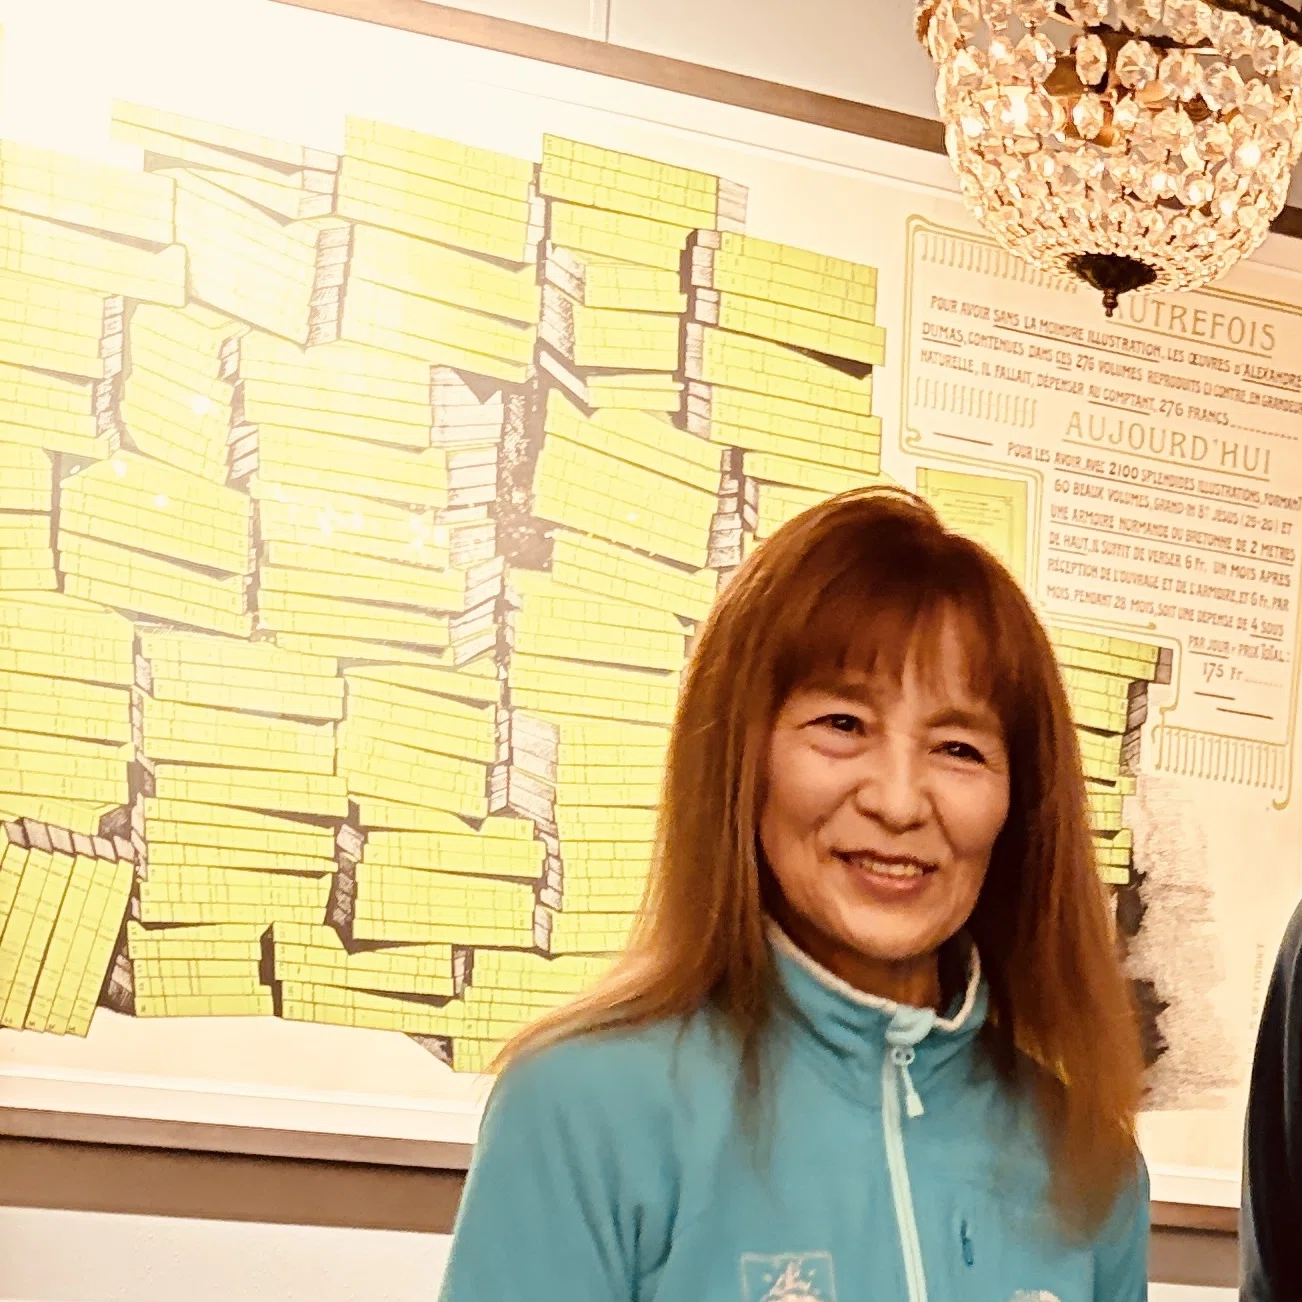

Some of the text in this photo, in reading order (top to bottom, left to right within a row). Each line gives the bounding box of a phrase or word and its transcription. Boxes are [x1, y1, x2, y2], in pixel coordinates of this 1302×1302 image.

[930, 295, 958, 313] POUR
[993, 308, 1020, 327] SANS
[1024, 316, 1037, 330] LA
[1168, 348, 1184, 362] LES
[1028, 344, 1053, 362] DANS
[1056, 350, 1072, 366] CES
[1076, 354, 1094, 372] 276
[1098, 360, 1142, 382] VOLUMES
[1159, 398, 1184, 418] 276
[1008, 442, 1032, 460] POUR
[1035, 448, 1050, 462] LES
[1108, 462, 1139, 480] 2100
[1065, 411, 1270, 474] AUJOURD'HUI
[1054, 478, 1070, 494] 60
[1073, 482, 1104, 500] BEAUX
[1050, 503, 1068, 520] UNE
[1072, 508, 1114, 529] ARMOIRE
[1119, 516, 1169, 538] NORMANDE
[1236, 538, 1247, 553] DE
[1250, 540, 1258, 554] 2
[1049, 531, 1060, 546] DE
[1133, 546, 1145, 562] DE
[1185, 554, 1193, 569] 6
[1230, 564, 1256, 581] MOIS
[1100, 566, 1111, 581] DE
[1162, 578, 1173, 591] ET
[1175, 580, 1187, 594] DE
[1250, 592, 1258, 606] 6
[1272, 597, 1290, 612] PAR
[1074, 589, 1113, 608] PENDANT
[1177, 607, 1195, 622] UNE
[1236, 617, 1247, 631] DE
[1250, 617, 1258, 630] 4
[1261, 620, 1284, 637] SOUS
[1188, 634, 1206, 649] PAR
[1203, 662, 1224, 683] 175
